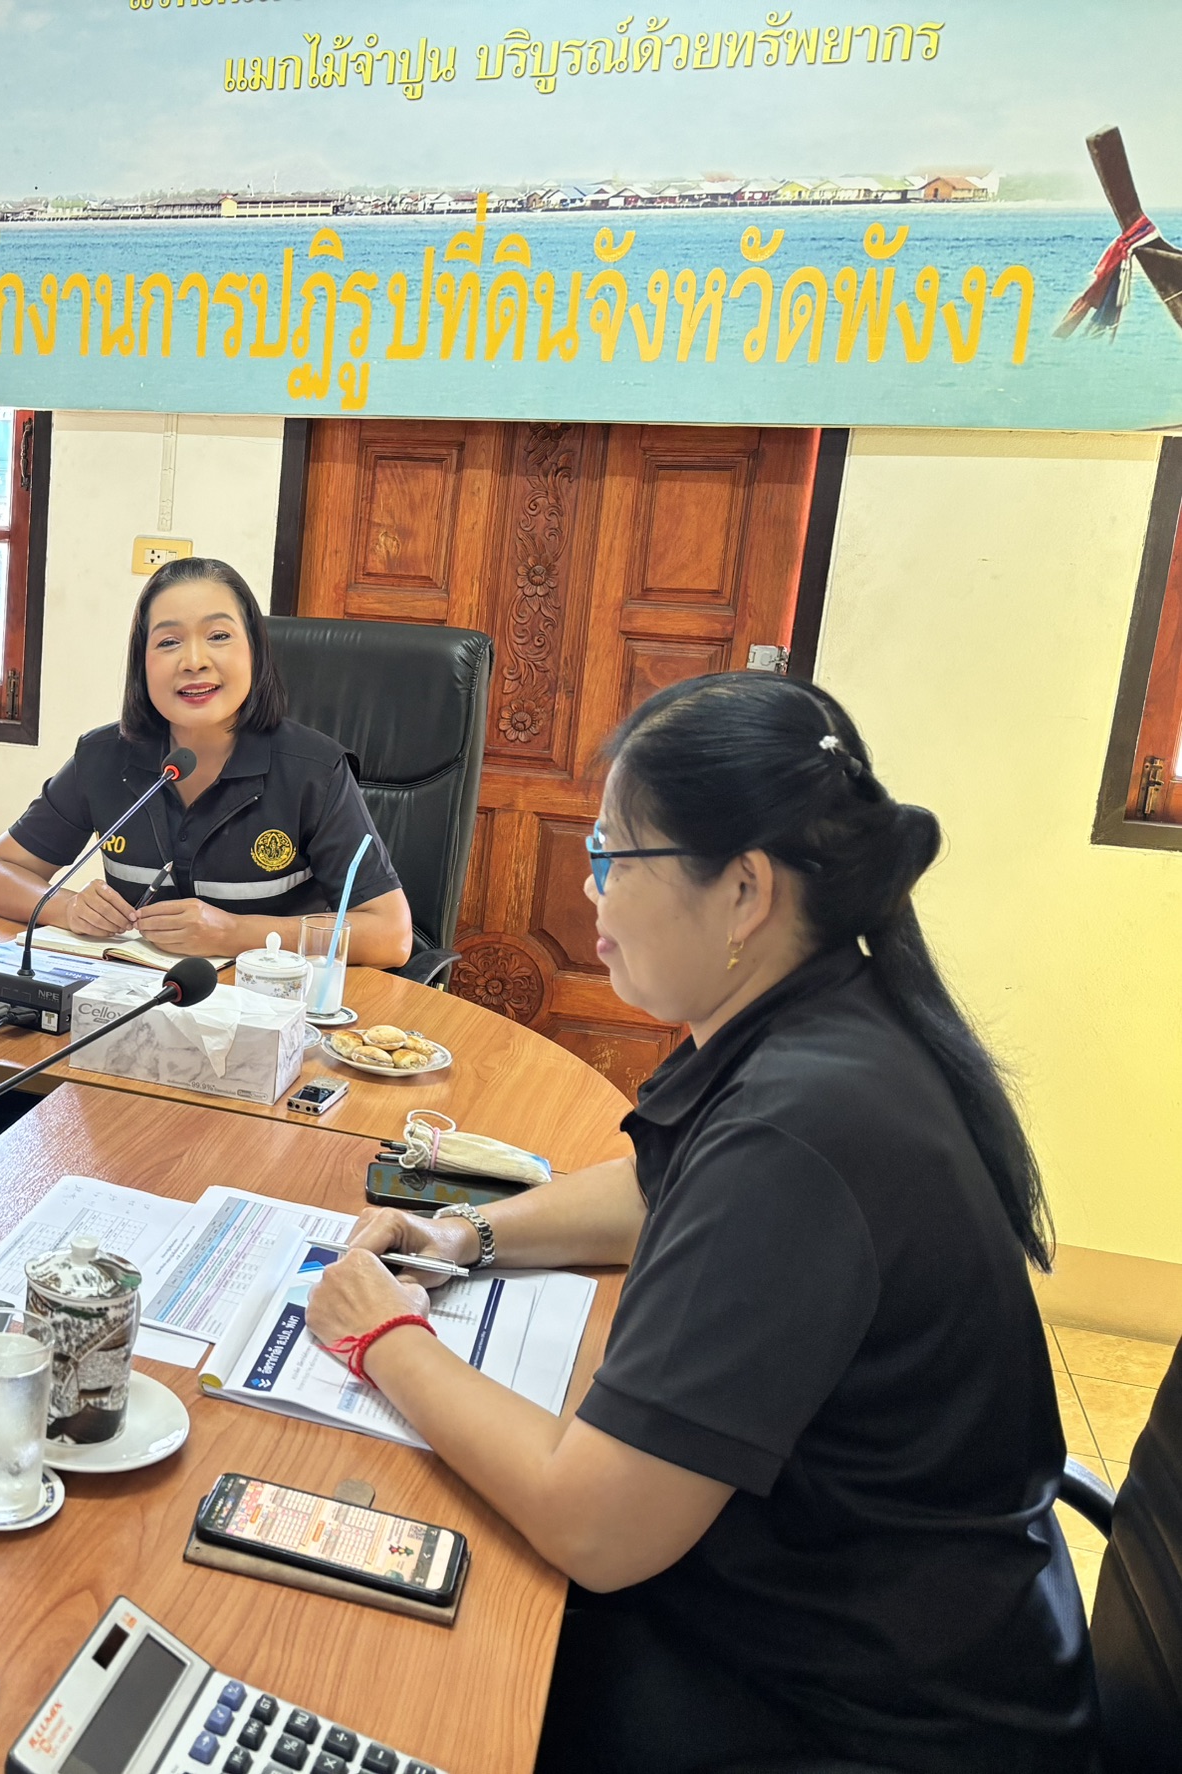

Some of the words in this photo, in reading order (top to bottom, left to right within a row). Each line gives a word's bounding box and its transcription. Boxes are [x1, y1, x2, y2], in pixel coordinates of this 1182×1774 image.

[223, 33, 456, 100] แมกไม้จำปูน
[475, 10, 945, 94] บริบูรณ์ด้วยทรัพยากร
[37, 989, 60, 1000] NPE
